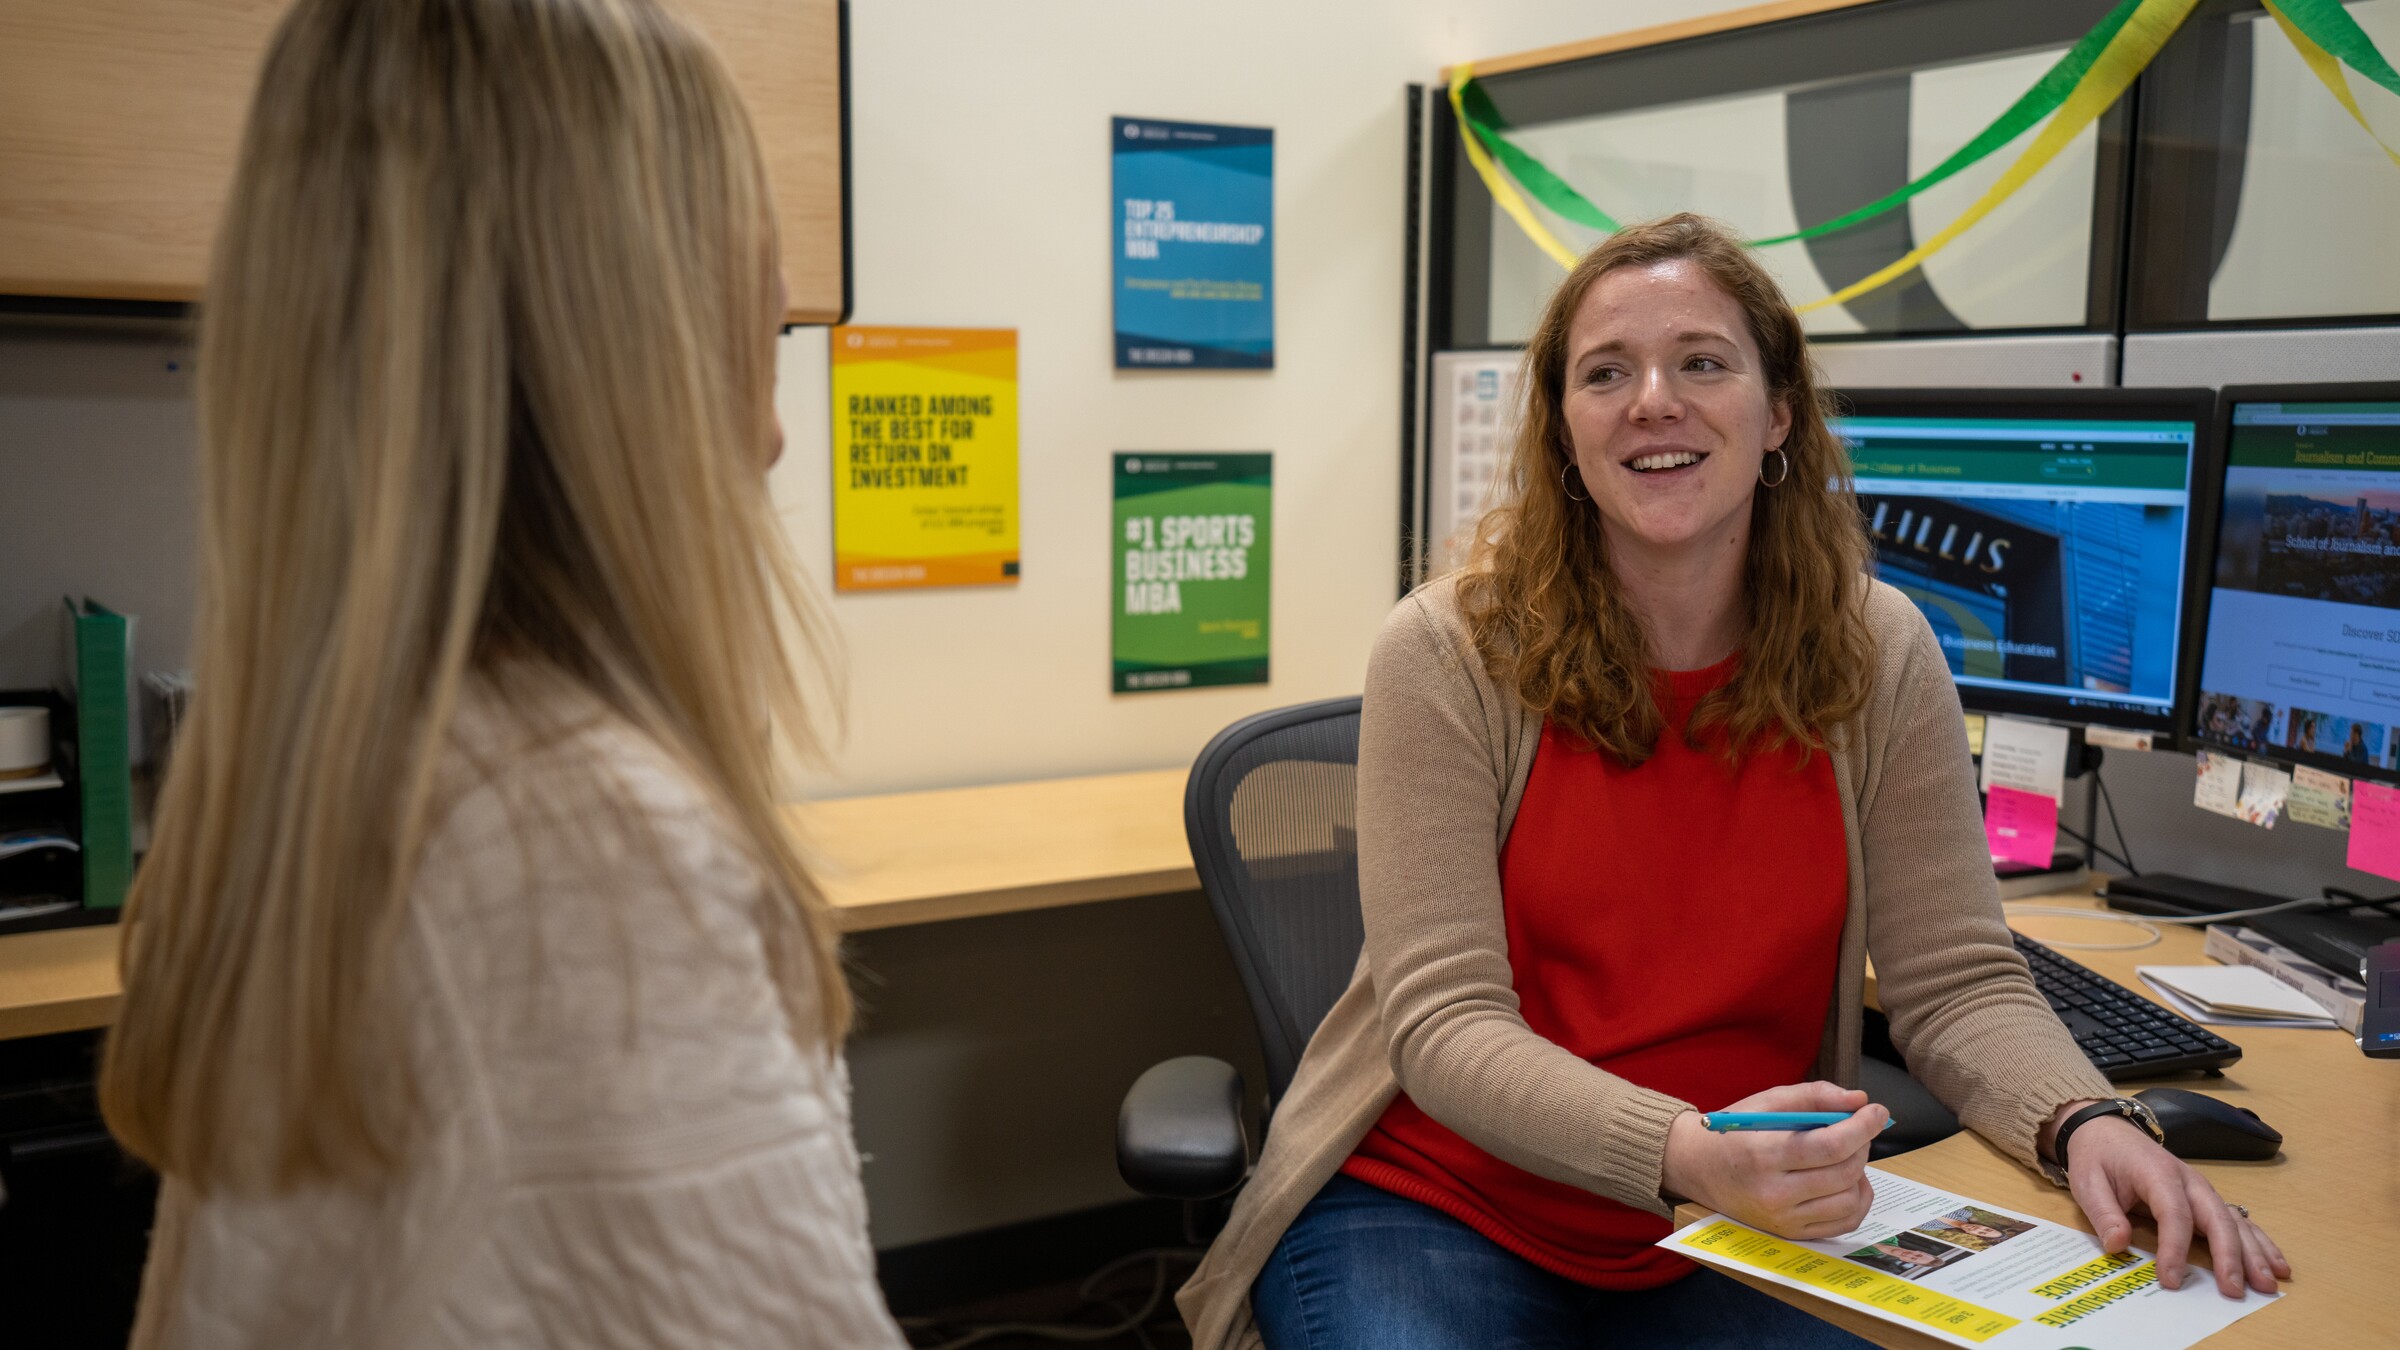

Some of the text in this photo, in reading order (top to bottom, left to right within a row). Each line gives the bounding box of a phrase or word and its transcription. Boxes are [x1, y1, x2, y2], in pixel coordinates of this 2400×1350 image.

[1125, 199, 1175, 221] TOP 25
[1125, 220, 1264, 245] ENTREPRENEURSHIP
[1125, 239, 1159, 259] MBA
[849, 395, 993, 417] RANKED AMONG
[850, 419, 975, 440] THE BEST FOR
[850, 443, 952, 464] RETURN ON
[2345, 451, 2364, 465] and
[850, 465, 969, 489] INVESTMENT
[1125, 515, 1255, 548] #1 SPORTS
[2285, 534, 2317, 551] School
[2330, 537, 2382, 556] Journalism
[1125, 548, 1247, 581] BUSINESS
[1125, 581, 1182, 615] MBA
[2342, 623, 2384, 642] Discover
[1943, 634, 1995, 652] Business
[1996, 639, 2056, 658] Education
[2035, 1251, 2144, 1300] EXPERIENCE
[2038, 1263, 2159, 1328] NDERGRADUATE
